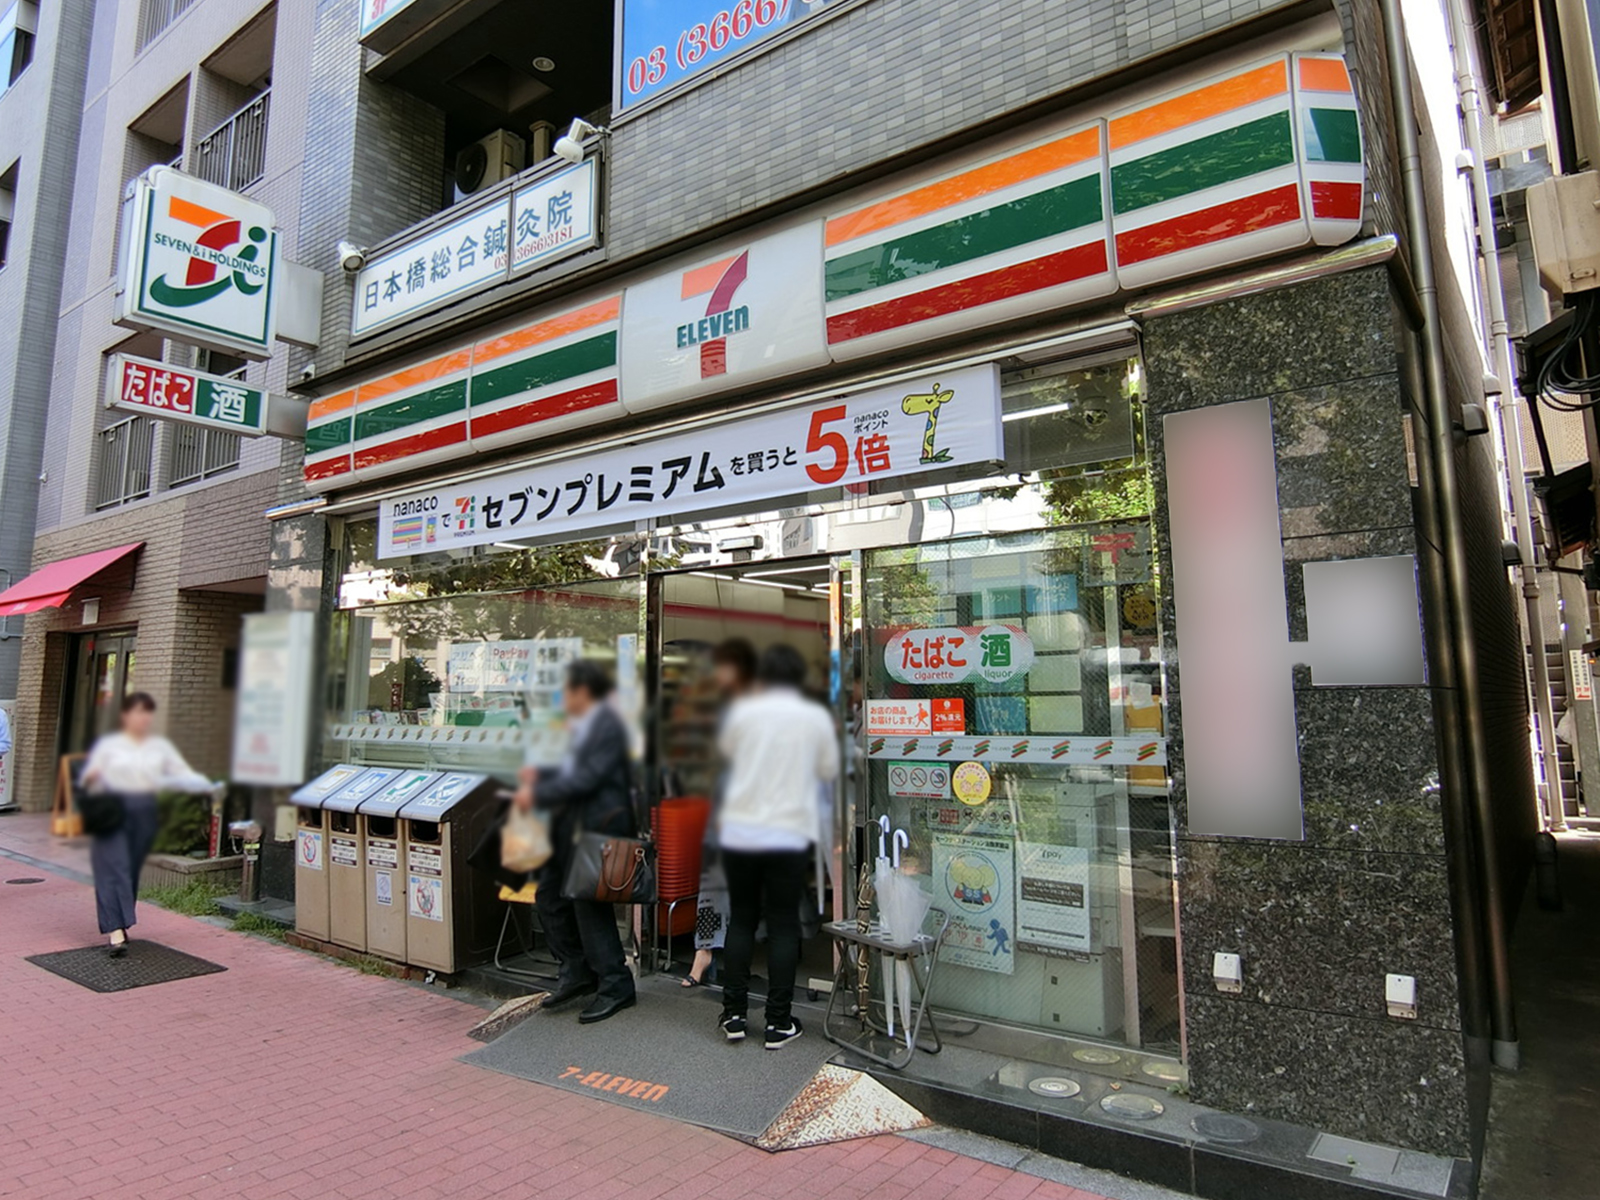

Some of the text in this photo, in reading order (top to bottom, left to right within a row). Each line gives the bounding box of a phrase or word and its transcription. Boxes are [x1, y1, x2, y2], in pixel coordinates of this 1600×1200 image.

[208, 250, 266, 278] HOLDINGS
[364, 190, 574, 313] 日本橋総合鍼灸院
[123, 364, 248, 423] たばこ 酒
[854, 409, 889, 423] nanaco
[854, 419, 889, 434] ポイント
[482, 451, 726, 529] セブンプレミアム
[730, 446, 798, 476] を買うと
[393, 495, 439, 517] nanaco
[902, 633, 1011, 669] たばこ 酒
[914, 671, 954, 681] cigarette
[984, 669, 1013, 679] liquor
